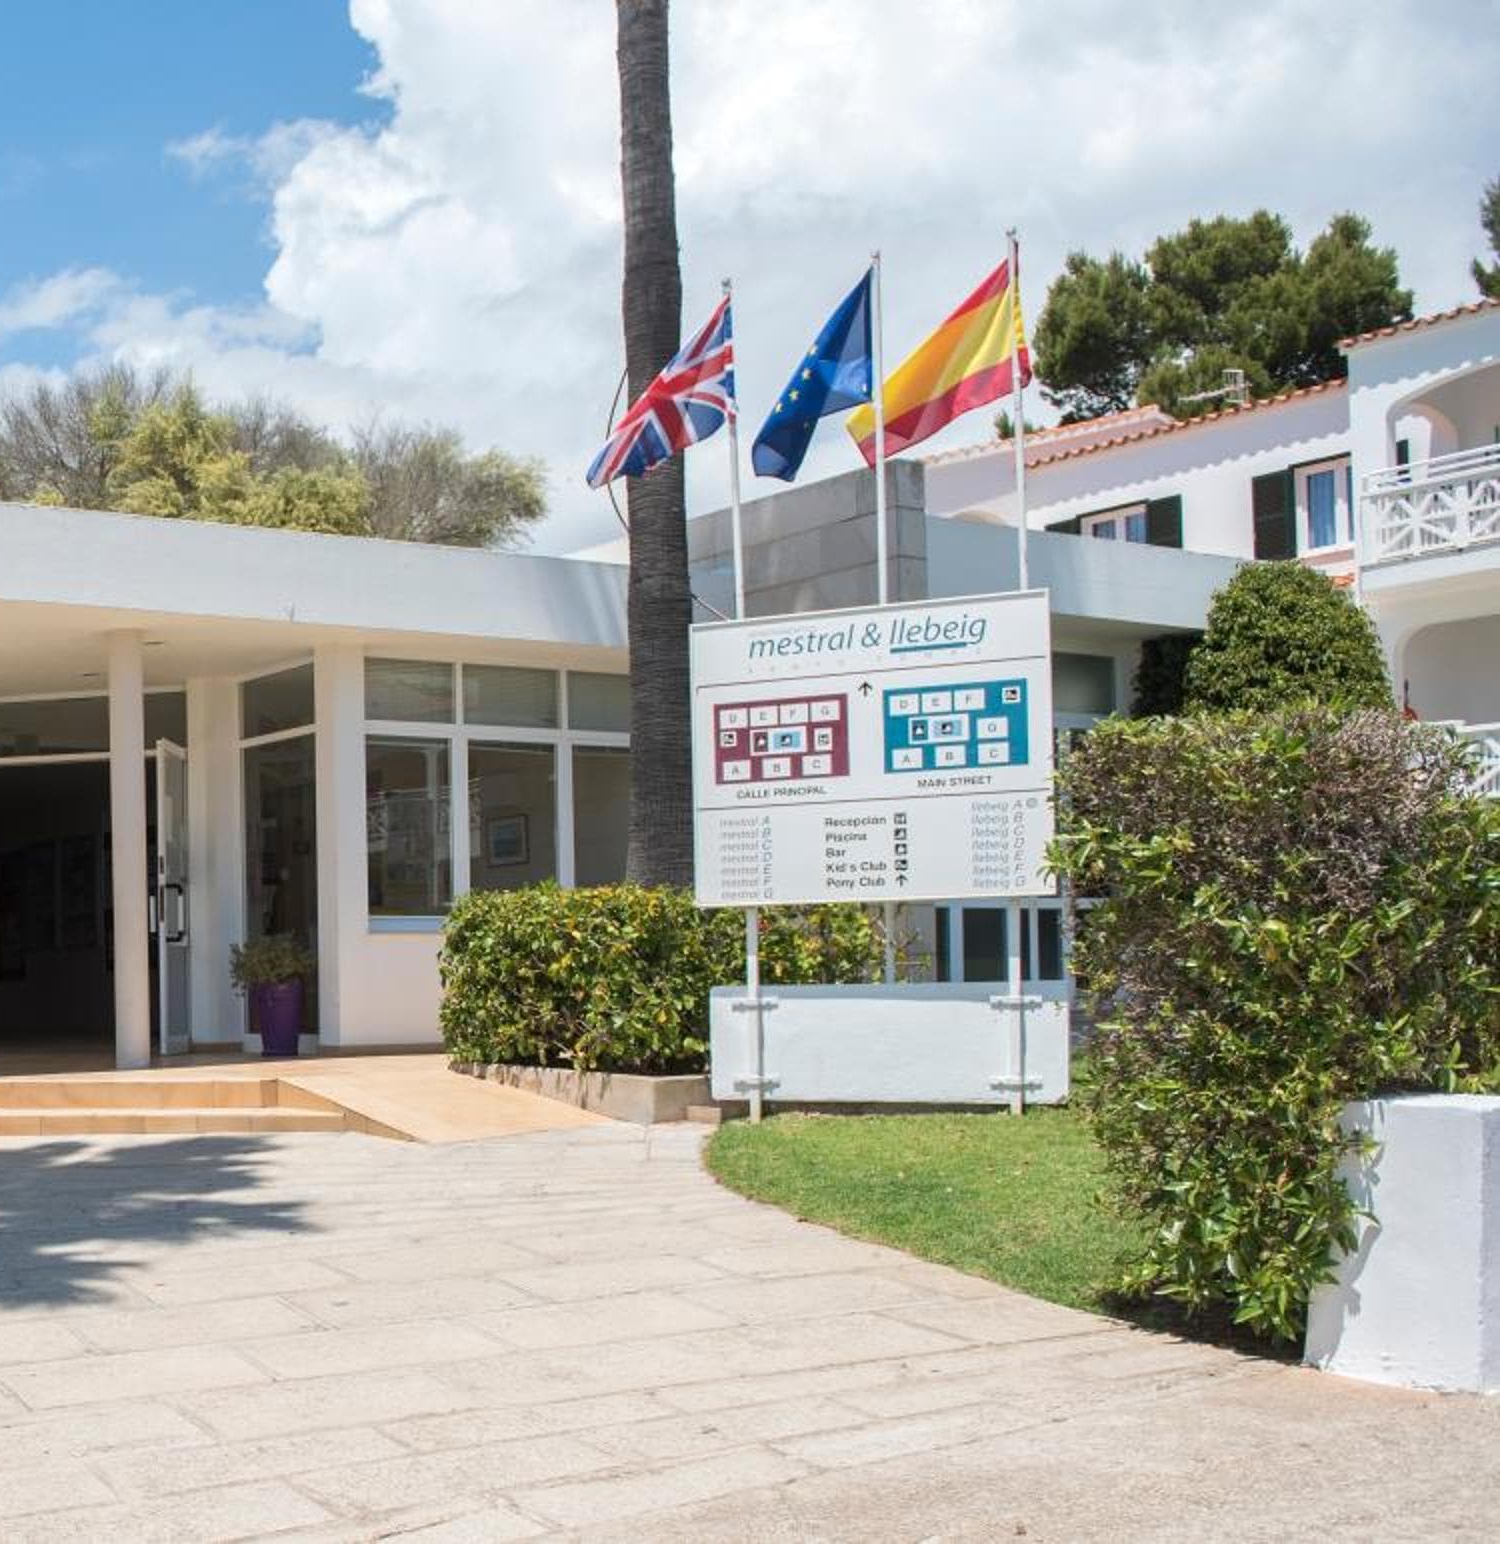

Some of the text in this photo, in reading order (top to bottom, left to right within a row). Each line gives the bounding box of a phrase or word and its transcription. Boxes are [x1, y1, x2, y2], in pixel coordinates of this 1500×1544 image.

[749, 614, 987, 659] mestral & llebeig
[917, 775, 993, 788] MAIN STREET
[737, 785, 828, 799] CALLE PRINCIPAL
[825, 832, 868, 842] Piscina
[825, 847, 846, 858] Bar
[860, 860, 887, 871] Club
[826, 876, 886, 890] Pony Club
